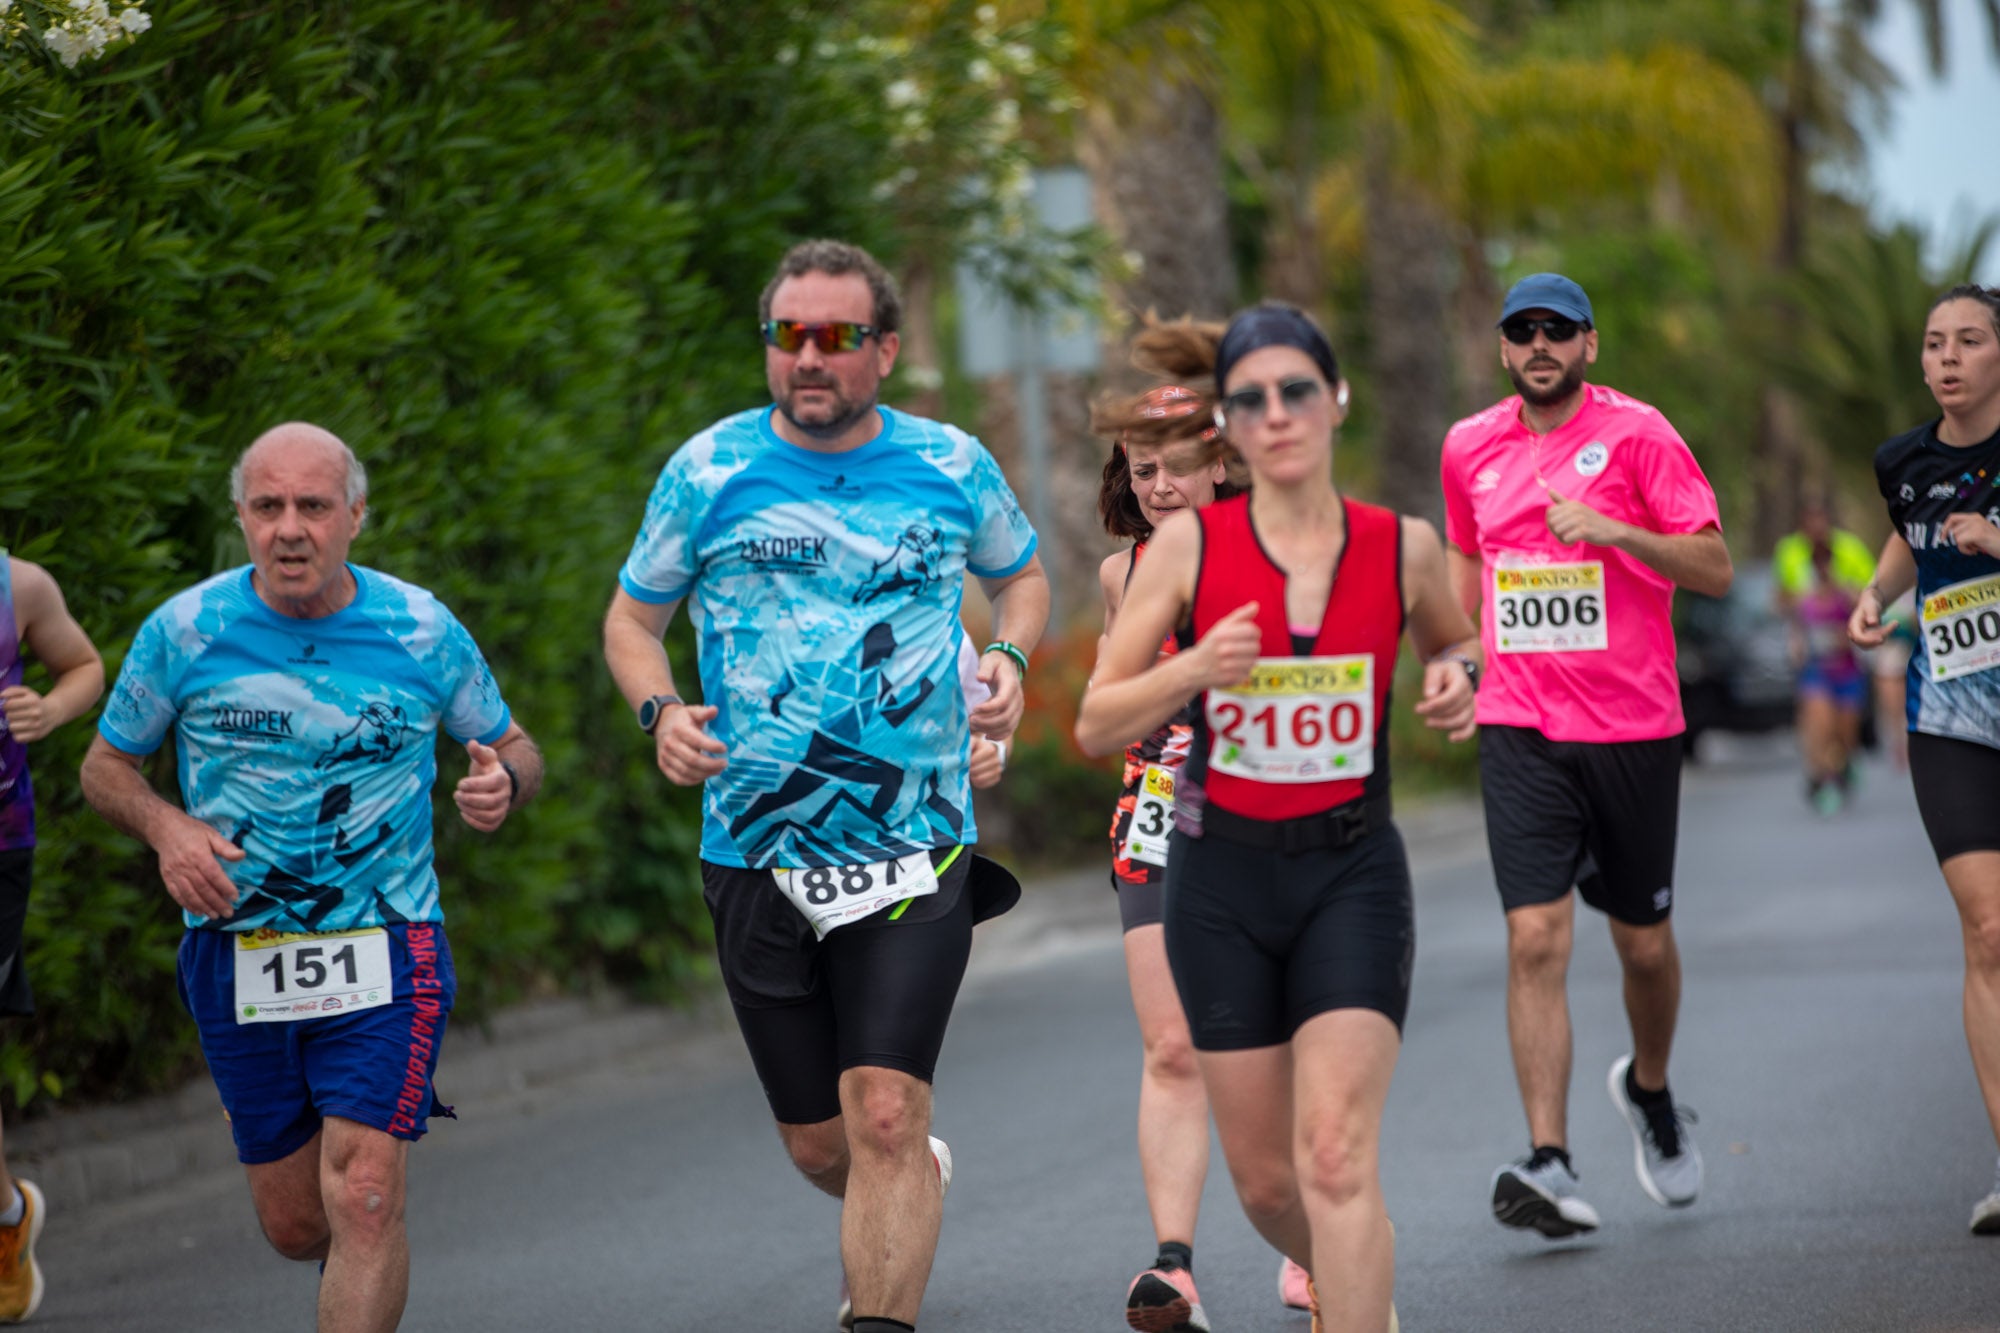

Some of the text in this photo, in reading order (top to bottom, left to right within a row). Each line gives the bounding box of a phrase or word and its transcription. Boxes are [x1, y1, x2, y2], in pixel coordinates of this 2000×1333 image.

[735, 537, 828, 562] ZATOPEK
[1501, 595, 1599, 628] 3006
[212, 709, 293, 735] ZATOPEK
[1214, 701, 1362, 748] 2160
[1158, 776, 1174, 795] 38
[262, 944, 358, 994] 151
